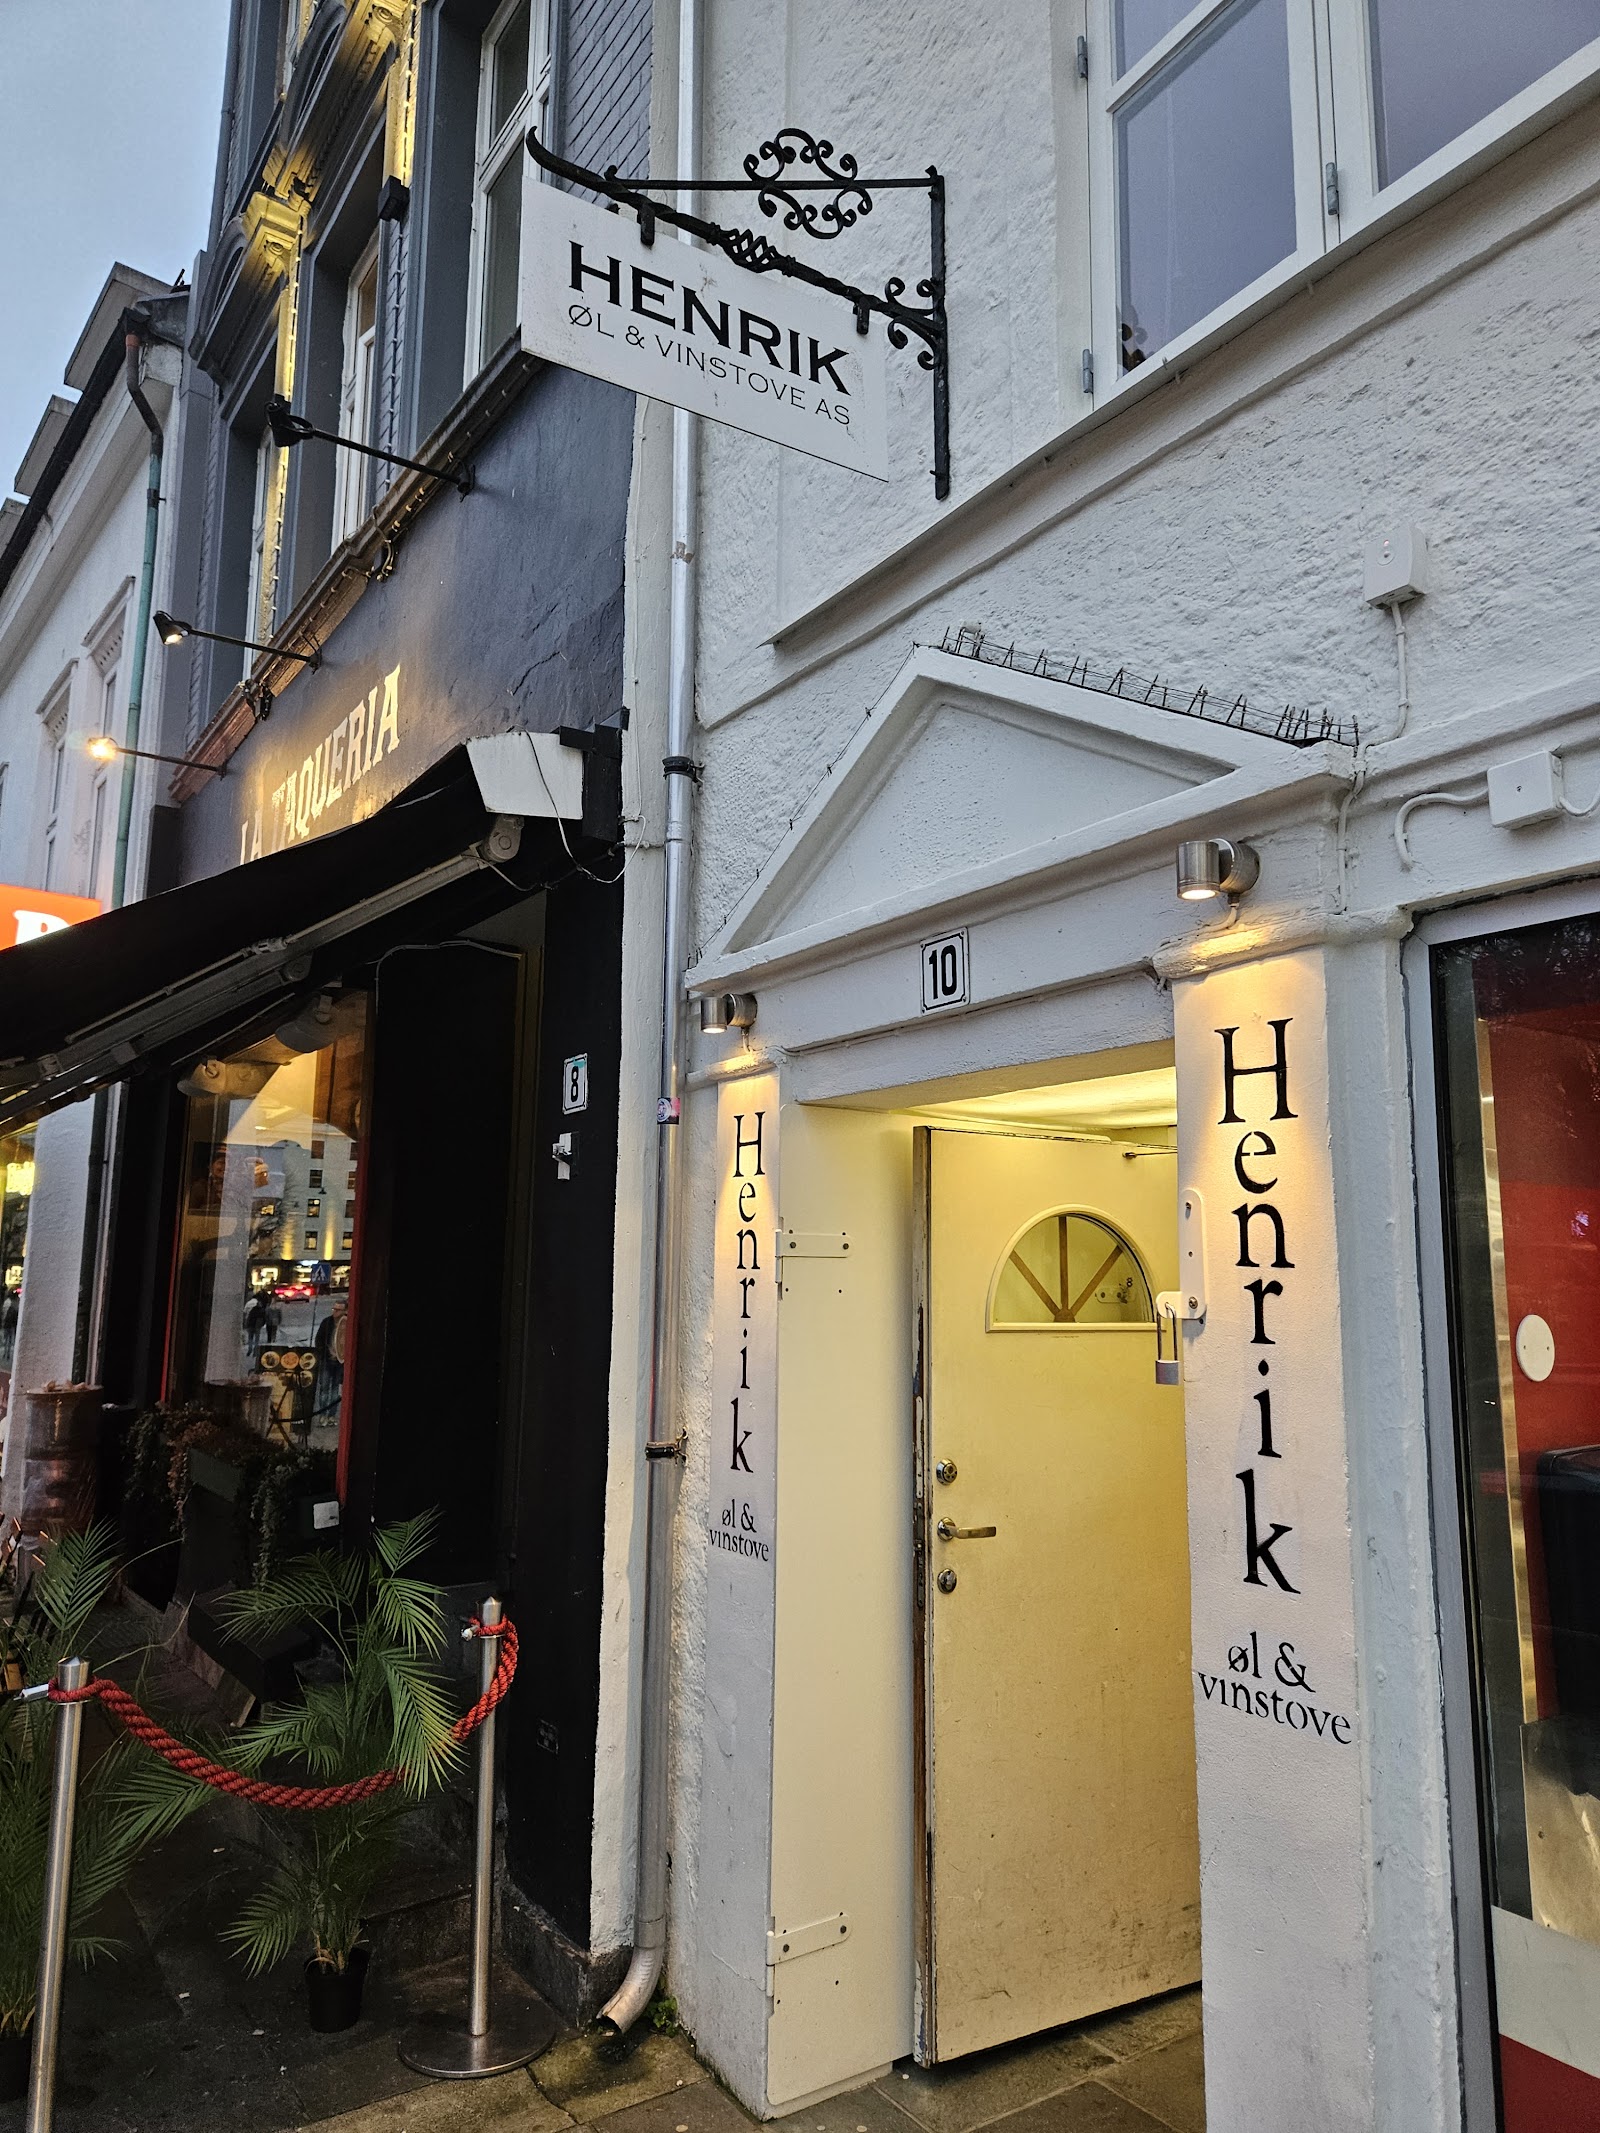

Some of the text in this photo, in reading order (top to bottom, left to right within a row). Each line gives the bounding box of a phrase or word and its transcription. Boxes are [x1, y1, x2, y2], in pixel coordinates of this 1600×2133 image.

[568, 240, 852, 397] HENRIK
[568, 304, 851, 425] ØL & VINSTOVE AS
[271, 663, 401, 850] TAQUERIA
[928, 943, 958, 1000] 10
[570, 1065, 579, 1103] 8
[731, 1111, 766, 1474] Henrik
[1214, 1017, 1302, 1595] Henrik
[709, 1529, 769, 1562] vinstove
[722, 1498, 757, 1534] øl &
[1228, 1630, 1316, 1693] øl &
[1198, 1671, 1352, 1745] vinstove
